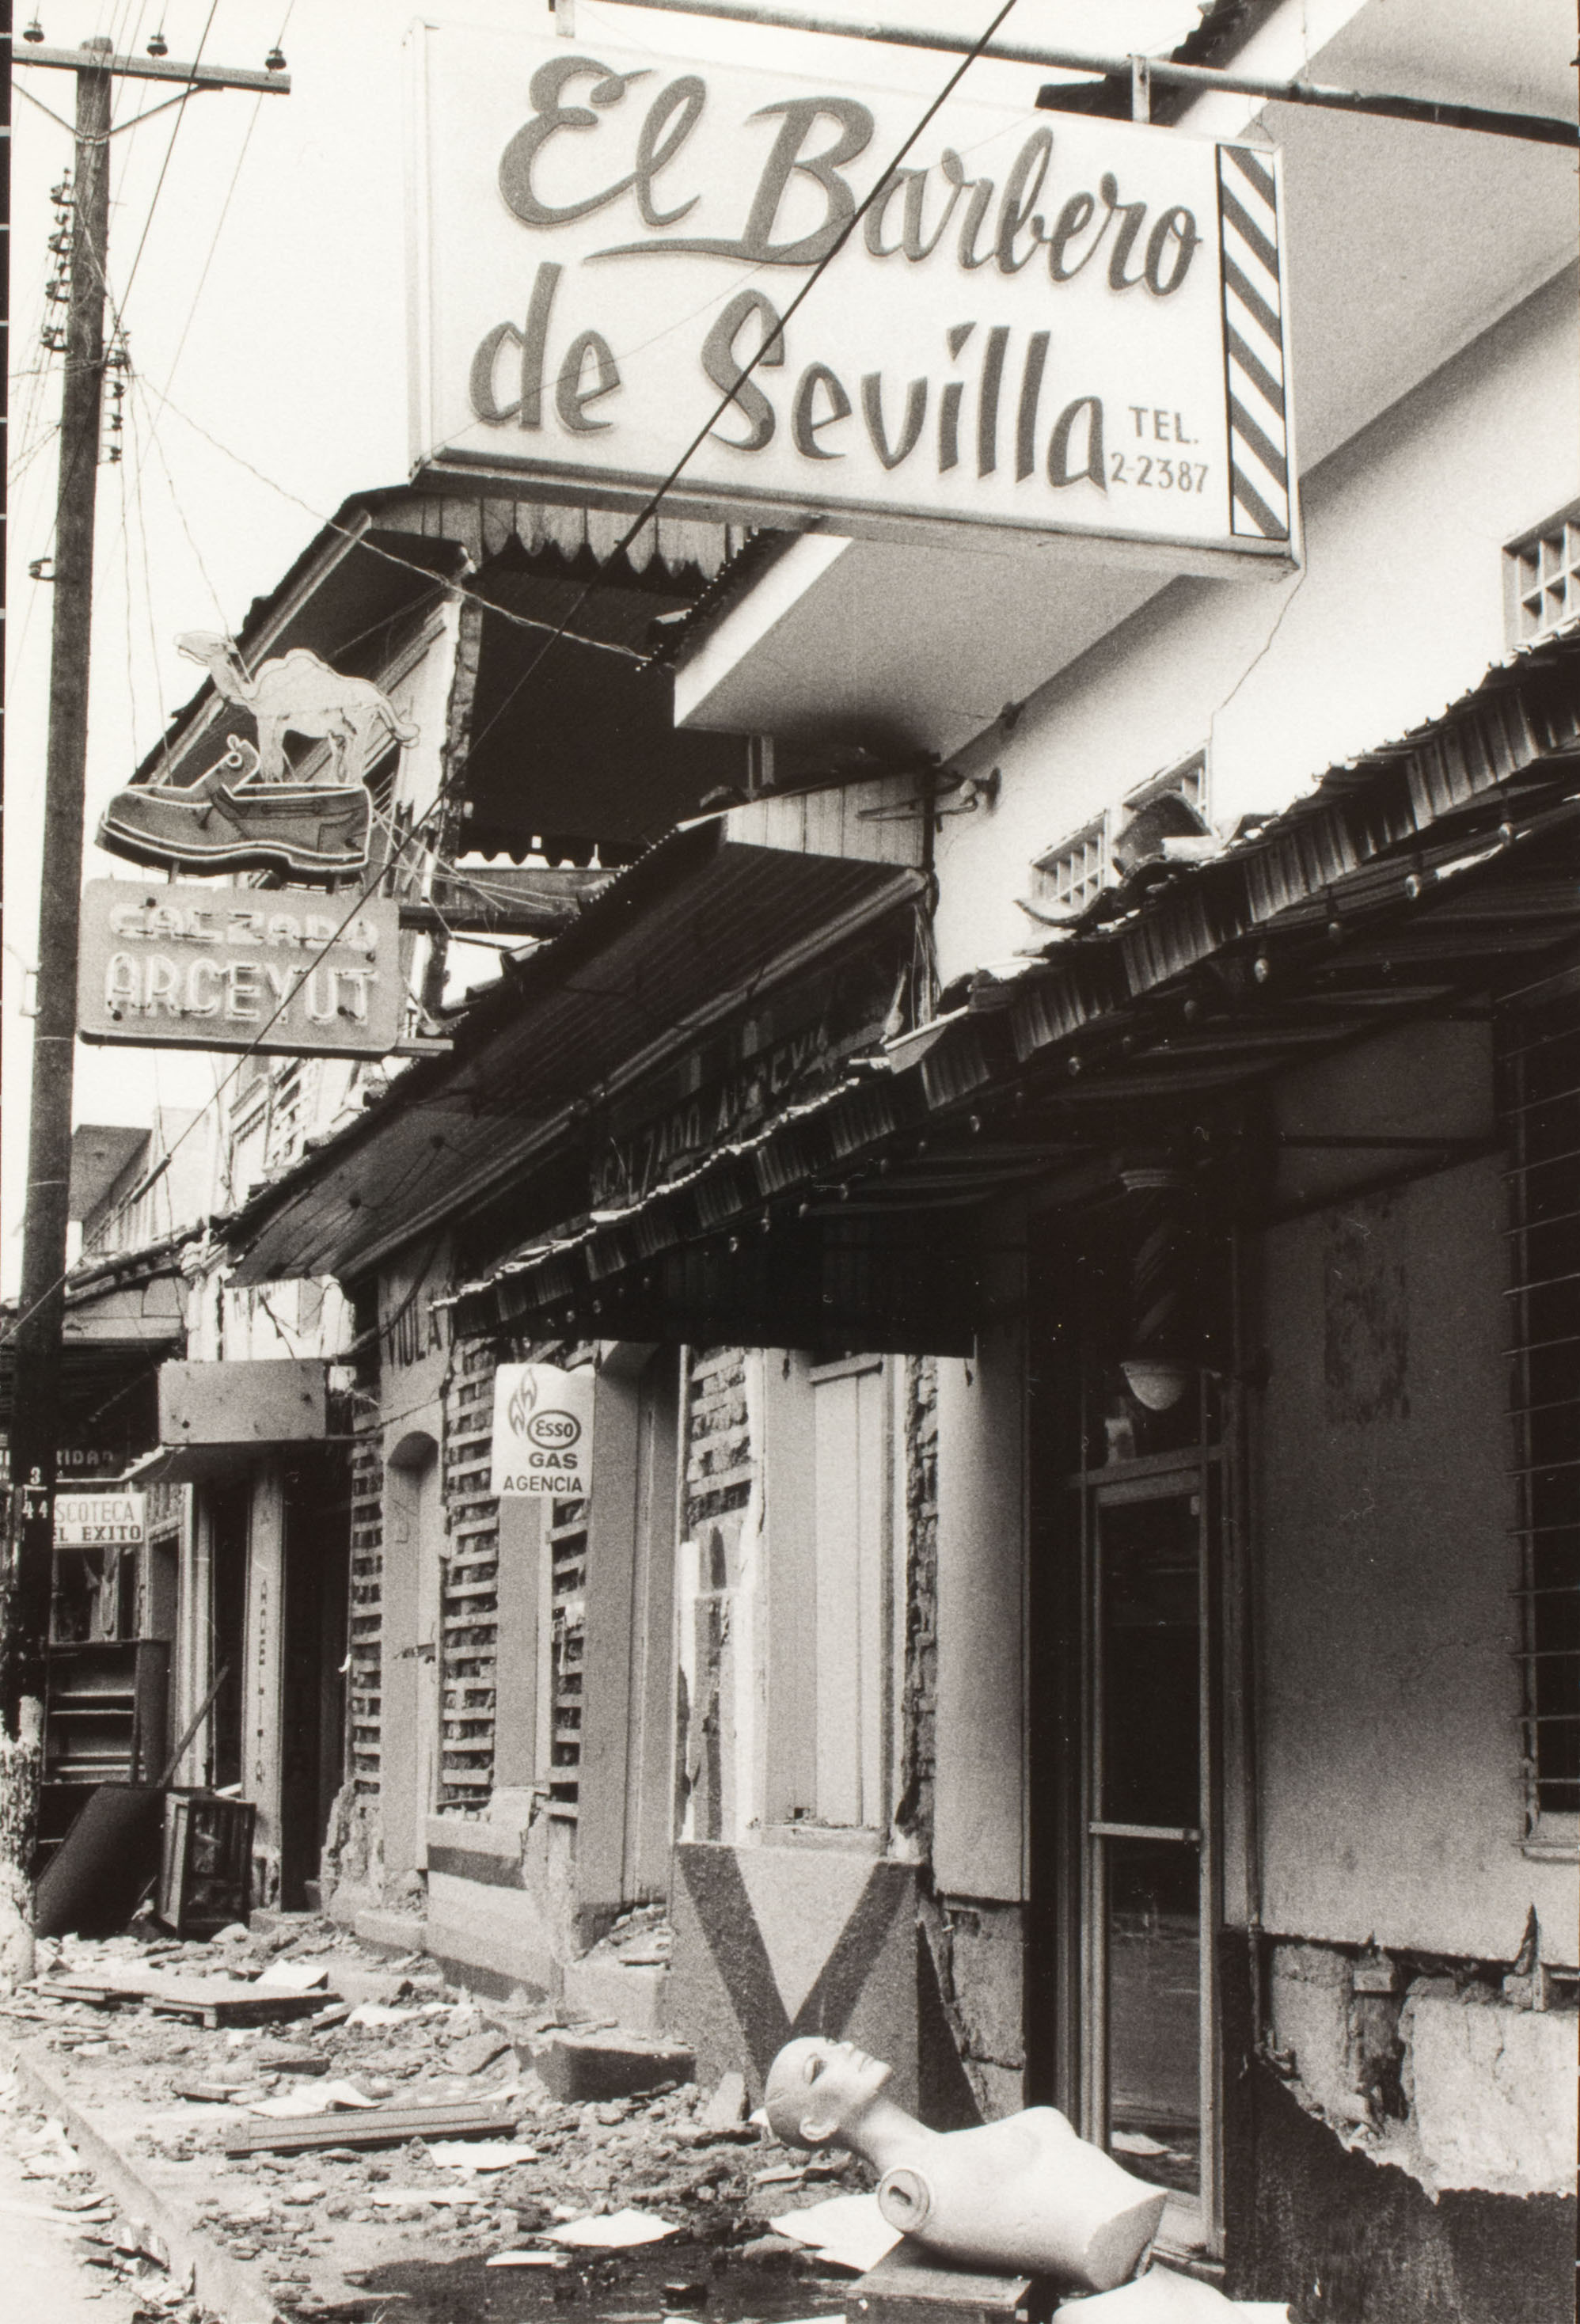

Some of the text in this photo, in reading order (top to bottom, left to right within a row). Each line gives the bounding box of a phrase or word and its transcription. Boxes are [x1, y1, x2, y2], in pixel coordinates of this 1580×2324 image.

[498, 55, 1202, 297] El Barbero
[470, 262, 1107, 493] de Sevilla
[1128, 405, 1199, 445] TEL.
[1111, 452, 1209, 494] 2-2387
[108, 902, 379, 953] CALZADO
[104, 951, 379, 1025] ARCEYUT
[30, 1467, 40, 1485] 3
[529, 1451, 579, 1470] GAS
[503, 1475, 583, 1493] AGENCIA
[82, 1525, 142, 1542] EXITO
